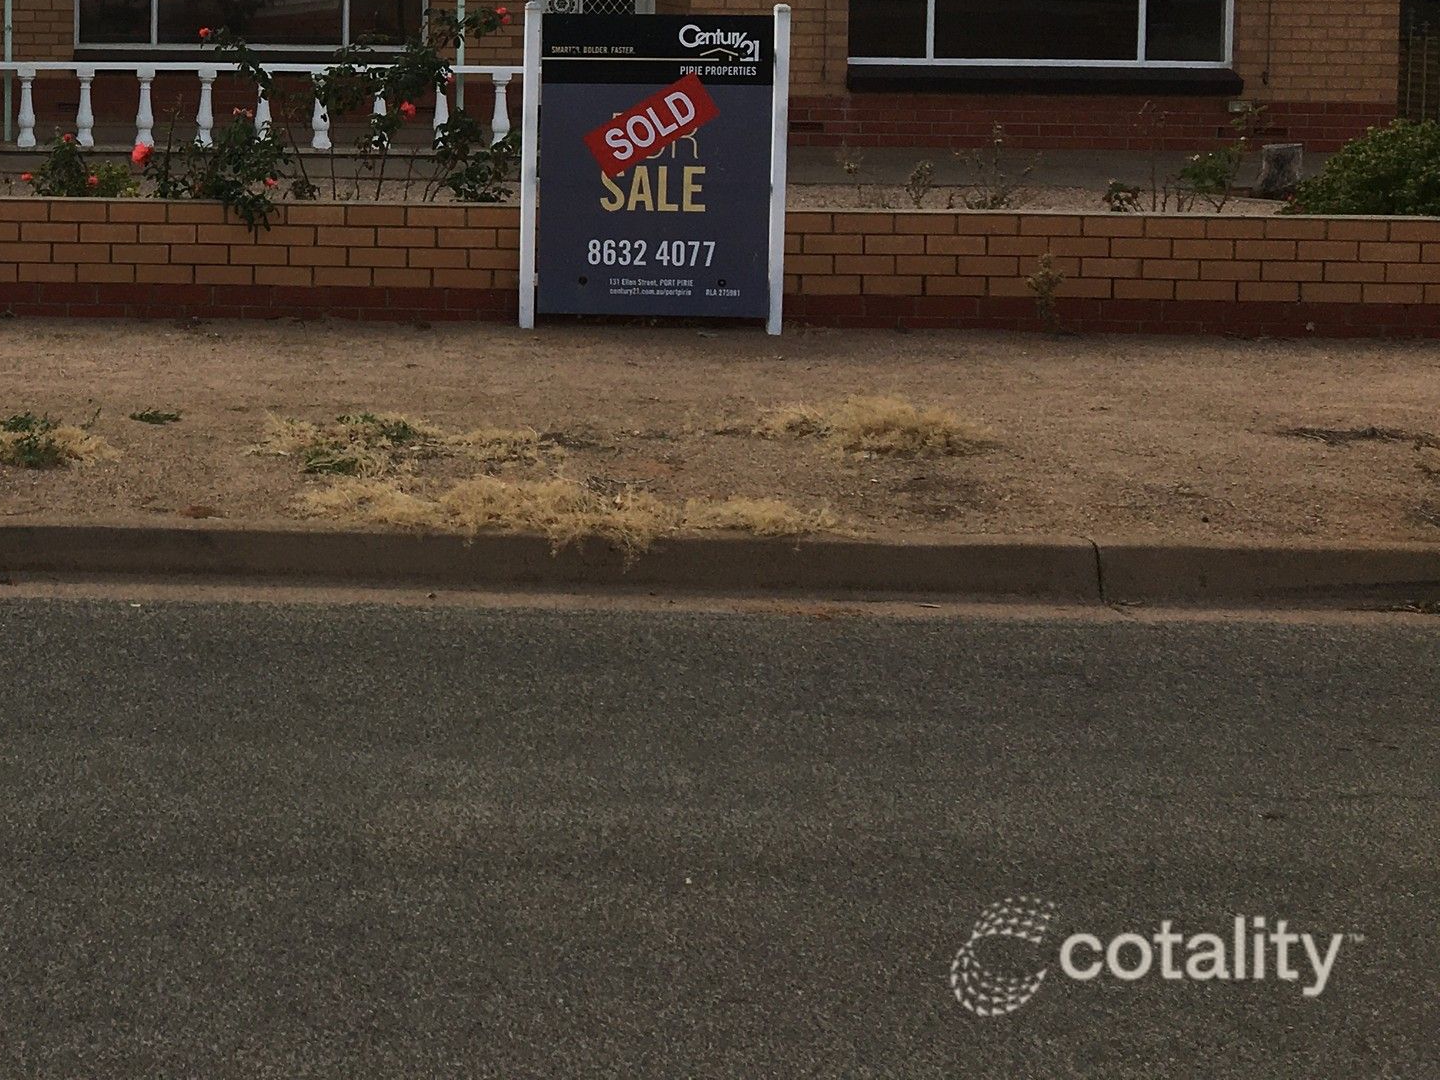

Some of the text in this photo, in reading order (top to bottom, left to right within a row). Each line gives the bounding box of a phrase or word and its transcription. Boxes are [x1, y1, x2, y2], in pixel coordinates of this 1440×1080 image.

[679, 24, 759, 61] Century 21
[705, 66, 757, 76] PROPERTIES
[605, 91, 696, 161] SOLD
[599, 165, 706, 212] SALE
[587, 239, 716, 267] 8632 4077
